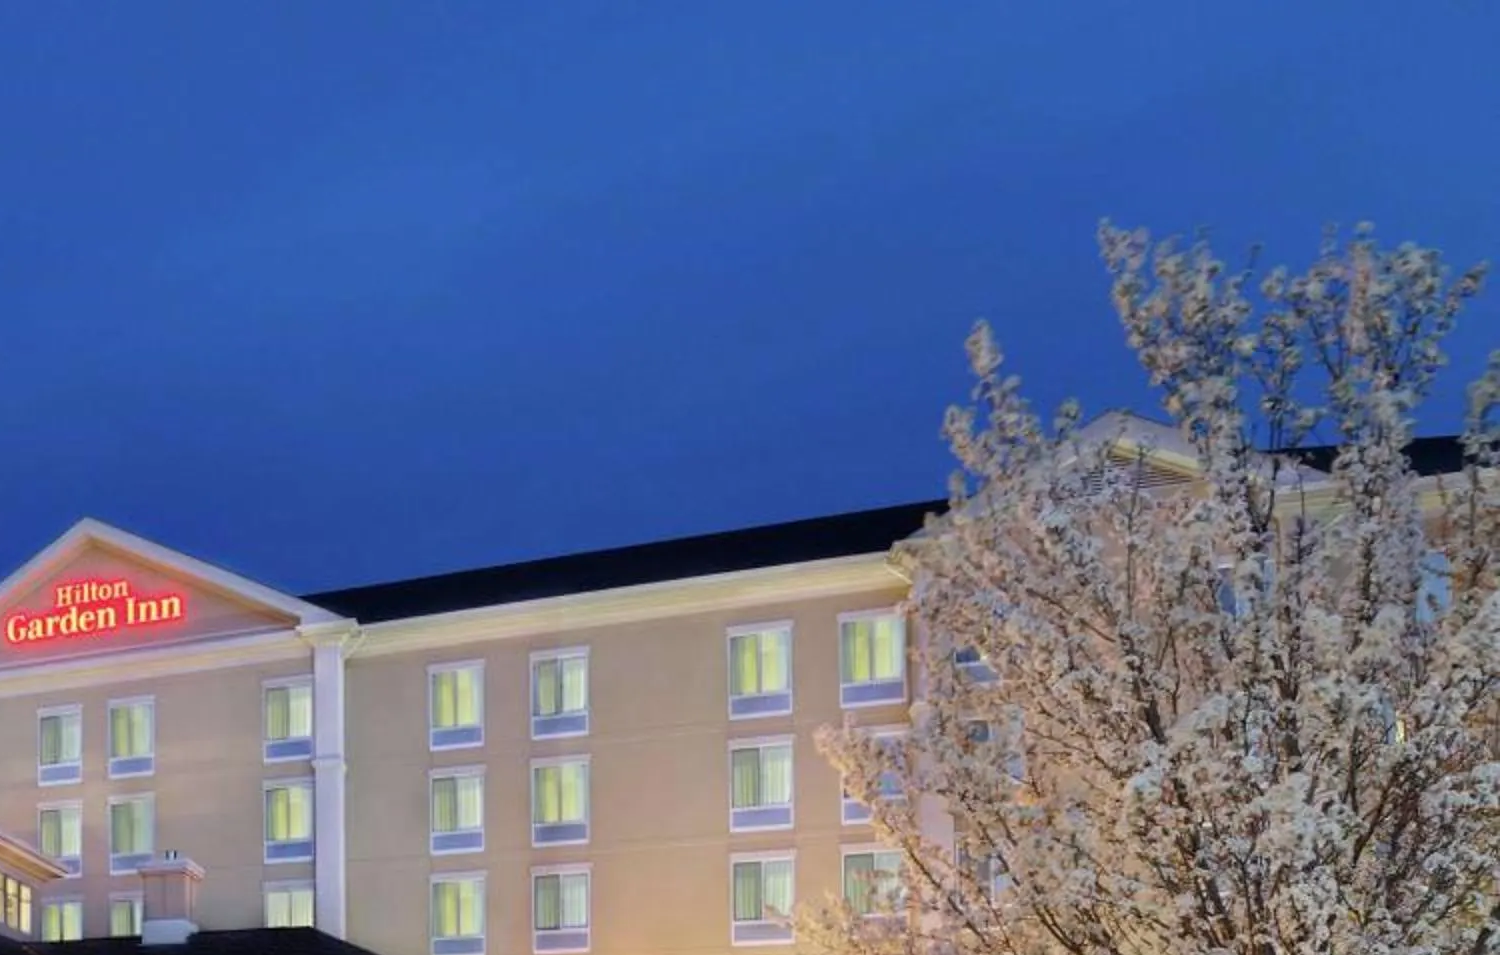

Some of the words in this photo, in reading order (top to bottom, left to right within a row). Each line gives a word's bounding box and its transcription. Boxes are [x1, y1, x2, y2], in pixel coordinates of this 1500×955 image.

[56, 580, 129, 607] Hilton
[6, 604, 117, 642] Garden
[125, 596, 182, 625] Inn
